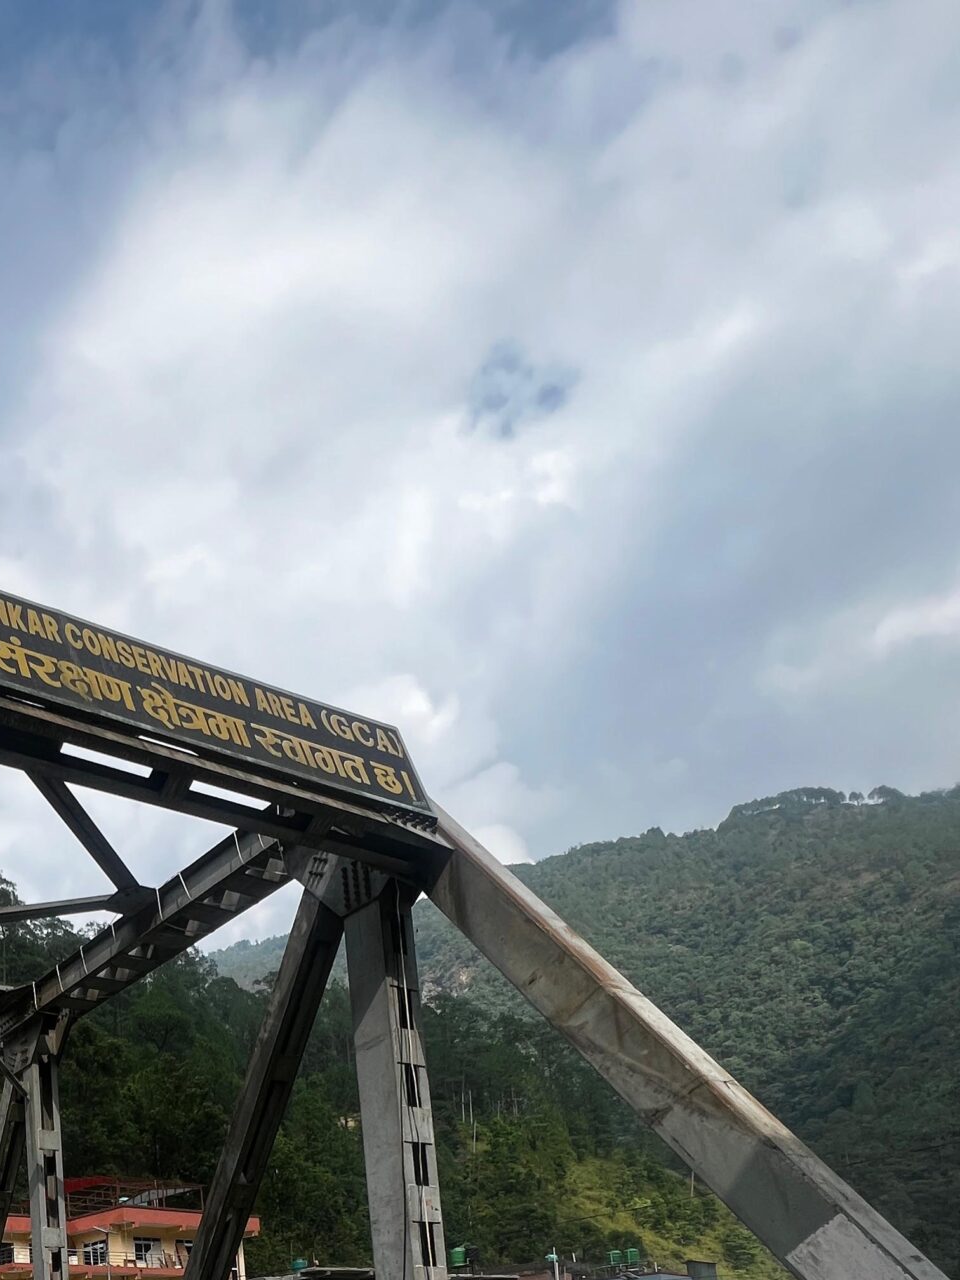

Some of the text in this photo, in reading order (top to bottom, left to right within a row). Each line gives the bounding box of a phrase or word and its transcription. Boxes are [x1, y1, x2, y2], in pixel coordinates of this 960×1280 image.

[63, 622, 250, 707] CONSERVATION
[254, 687, 317, 729] AREA
[320, 709, 404, 759] (GCA)
[136, 681, 252, 749] क्षेत्रमा
[251, 722, 371, 786] स्वागत
